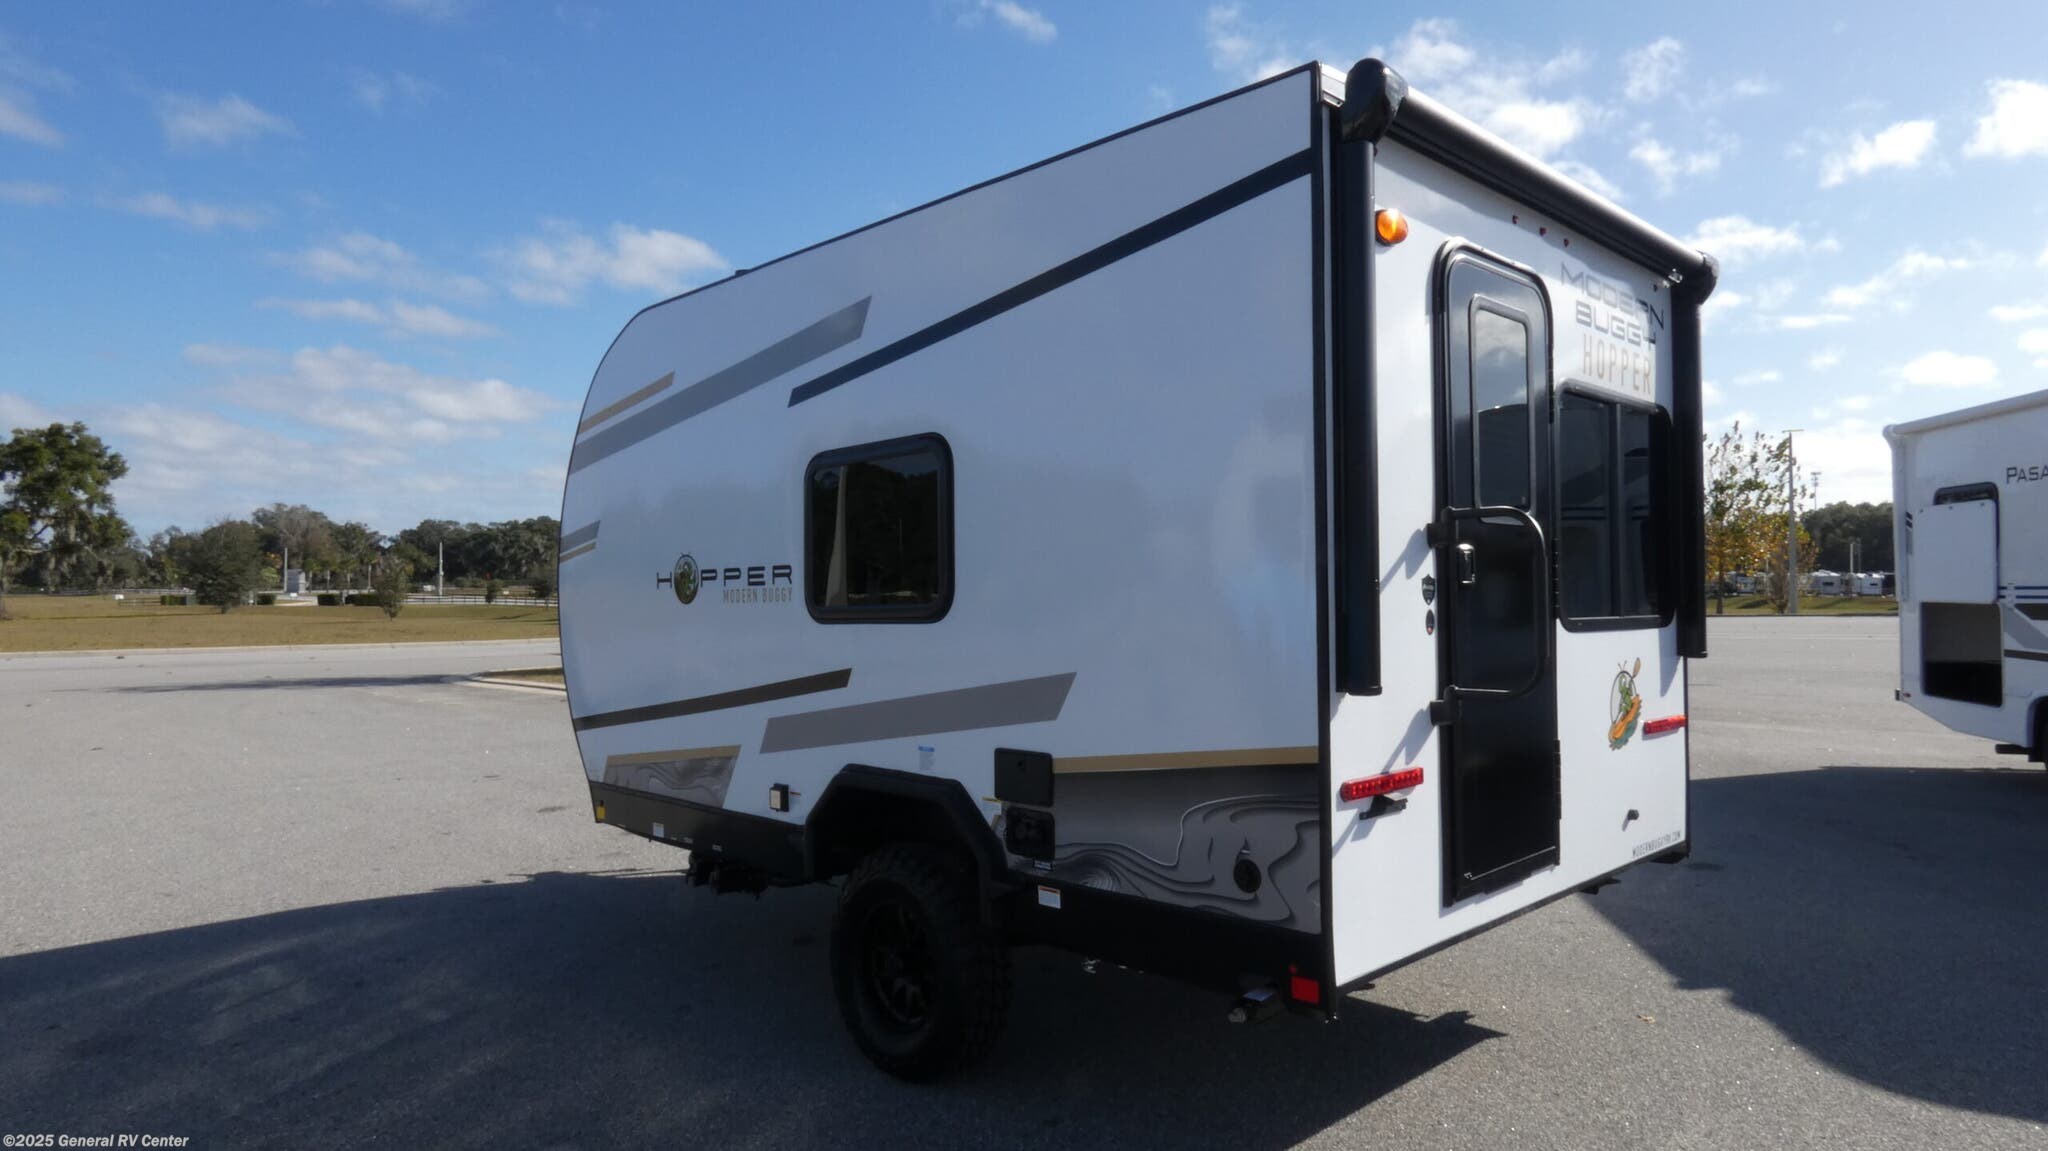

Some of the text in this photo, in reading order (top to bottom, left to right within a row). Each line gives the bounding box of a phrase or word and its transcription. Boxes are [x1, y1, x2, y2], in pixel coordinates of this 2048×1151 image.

[1561, 261, 1665, 330] MODERN
[1575, 300, 1657, 351] BUGGY
[1582, 333, 1653, 394] HOPPER
[723, 587, 793, 604] MODERN BUGGY
